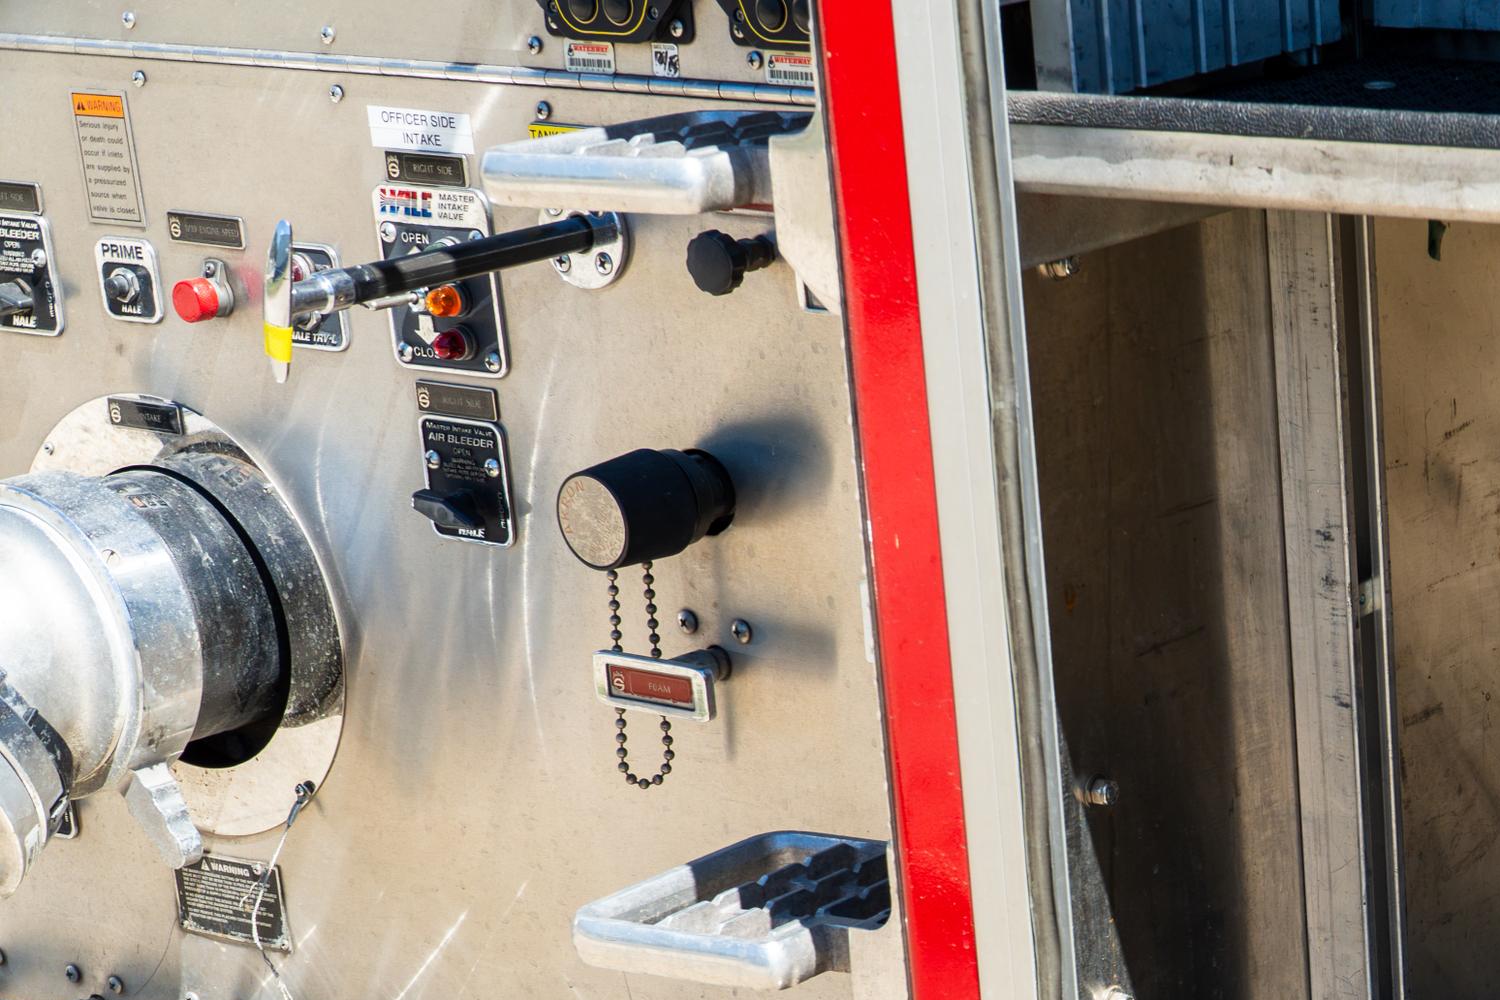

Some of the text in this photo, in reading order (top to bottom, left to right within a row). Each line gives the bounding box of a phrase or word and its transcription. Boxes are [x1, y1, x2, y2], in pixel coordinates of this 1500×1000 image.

[86, 100, 121, 113] WARNING
[381, 111, 456, 129] OFFICER SIDE
[403, 132, 442, 147] INTAKE
[412, 163, 453, 175] RIGHT SIDE
[439, 193, 475, 203] MASTER
[438, 203, 469, 212] INTAKE
[438, 212, 464, 221] VALVE
[401, 231, 430, 245] OPEN
[101, 242, 144, 261] PRIME
[121, 303, 142, 315] HALE
[12, 314, 38, 329] HALE
[428, 432, 494, 449] AIR BLEEDER
[210, 862, 251, 878] WARNING
